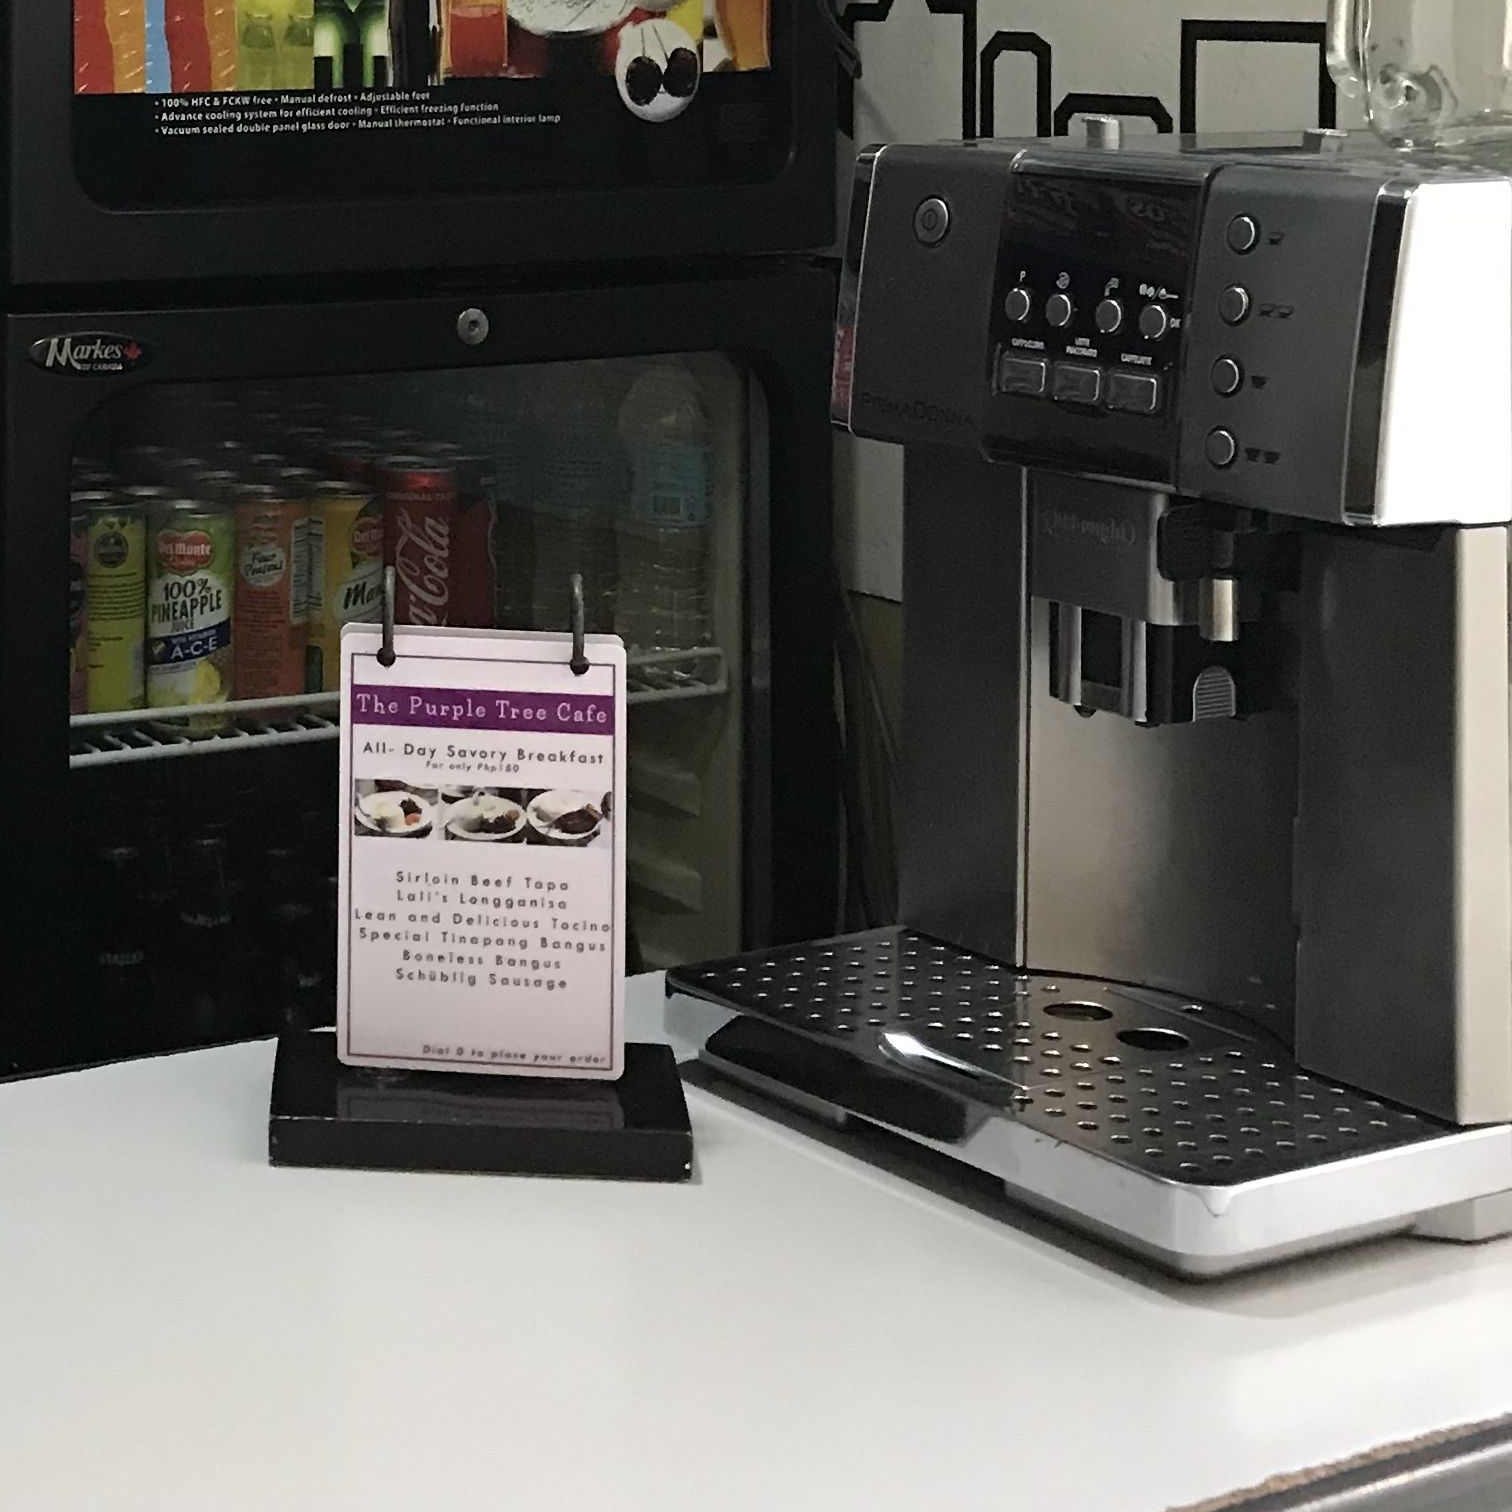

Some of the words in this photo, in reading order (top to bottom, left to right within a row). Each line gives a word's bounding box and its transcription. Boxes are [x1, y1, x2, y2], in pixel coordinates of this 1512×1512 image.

[161, 97, 189, 108] 100%
[191, 96, 210, 107] HFC
[253, 95, 273, 105] free
[280, 93, 316, 105] Manual
[318, 92, 352, 104] defrost
[360, 91, 410, 104] Adjustable
[412, 90, 430, 101] feet
[161, 111, 203, 122] Advance
[205, 109, 242, 122] cooling
[244, 108, 277, 121] system
[279, 107, 293, 118] for
[296, 106, 336, 117] efficient
[337, 105, 372, 117] cooling
[380, 104, 419, 115] Efficient
[421, 103, 459, 115] freezing
[460, 102, 499, 113] function
[161, 125, 200, 136] Vacuum
[202, 123, 234, 134] sealed
[237, 122, 271, 133] double
[272, 121, 300, 134] panel
[301, 120, 326, 133] glass
[327, 119, 350, 130] door
[358, 118, 393, 129] Manual
[394, 117, 446, 128] thermostat
[452, 115, 501, 126] Functional
[502, 113, 537, 124] interior
[538, 113, 561, 125] lamp
[44, 337, 124, 370] Markes
[164, 578, 212, 602] 100%
[151, 589, 222, 624] PINEAPPLE
[171, 637, 218, 660] A-C-E
[356, 692, 400, 715] The
[408, 695, 487, 722] Purple
[495, 699, 548, 721] Tree
[556, 702, 609, 724] Cafe
[403, 743, 437, 760] Day
[446, 744, 508, 763] Savory
[516, 747, 605, 765] Breakfast
[449, 761, 472, 773] only
[395, 870, 459, 886] Sirloin
[470, 874, 513, 889] Beef
[524, 876, 569, 893] Tapa
[397, 889, 449, 904] Lali's
[459, 892, 568, 910] Longganisa
[354, 908, 397, 922] Lean
[408, 911, 442, 924] and
[452, 912, 540, 930] Delicious
[359, 926, 430, 944] Special
[441, 930, 529, 951] Tinapang
[539, 937, 606, 954] Bangus
[402, 949, 484, 966] Boneless
[494, 954, 562, 972] Bangus
[488, 972, 568, 990] Sausage
[422, 1043, 450, 1057] Dial
[471, 1046, 485, 1058] to
[490, 1048, 528, 1062] place
[532, 1050, 563, 1063] your
[568, 1051, 606, 1065] order
